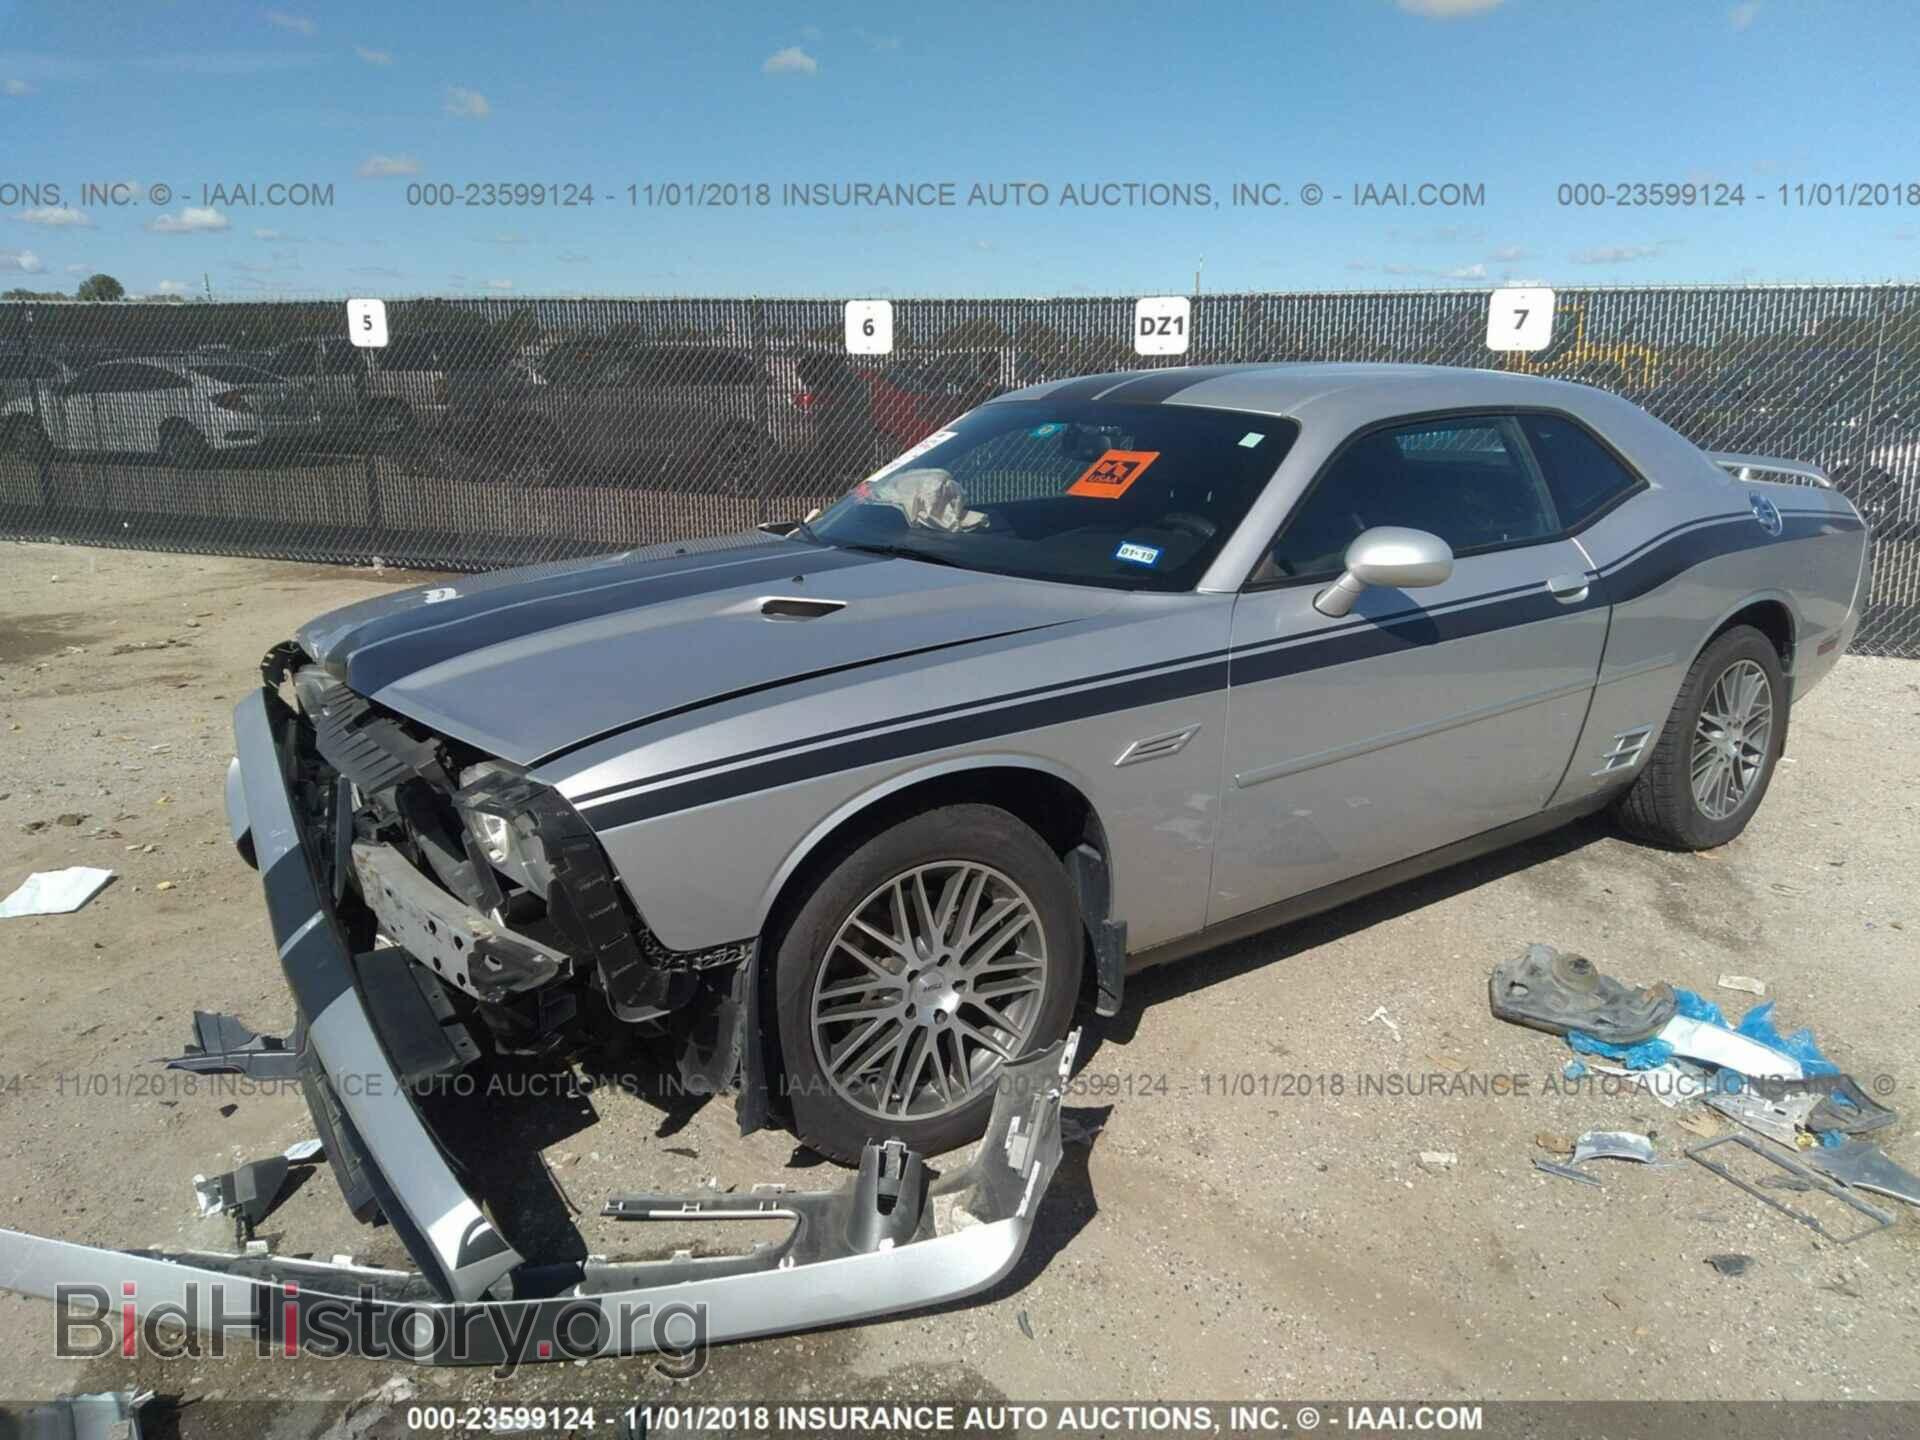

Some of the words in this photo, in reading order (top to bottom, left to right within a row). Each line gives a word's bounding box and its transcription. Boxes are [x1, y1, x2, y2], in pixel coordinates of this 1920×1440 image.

[363, 314, 373, 330] 5
[862, 318, 875, 337] 6
[1140, 315, 1184, 336] DZ1
[1513, 309, 1530, 330] 7
